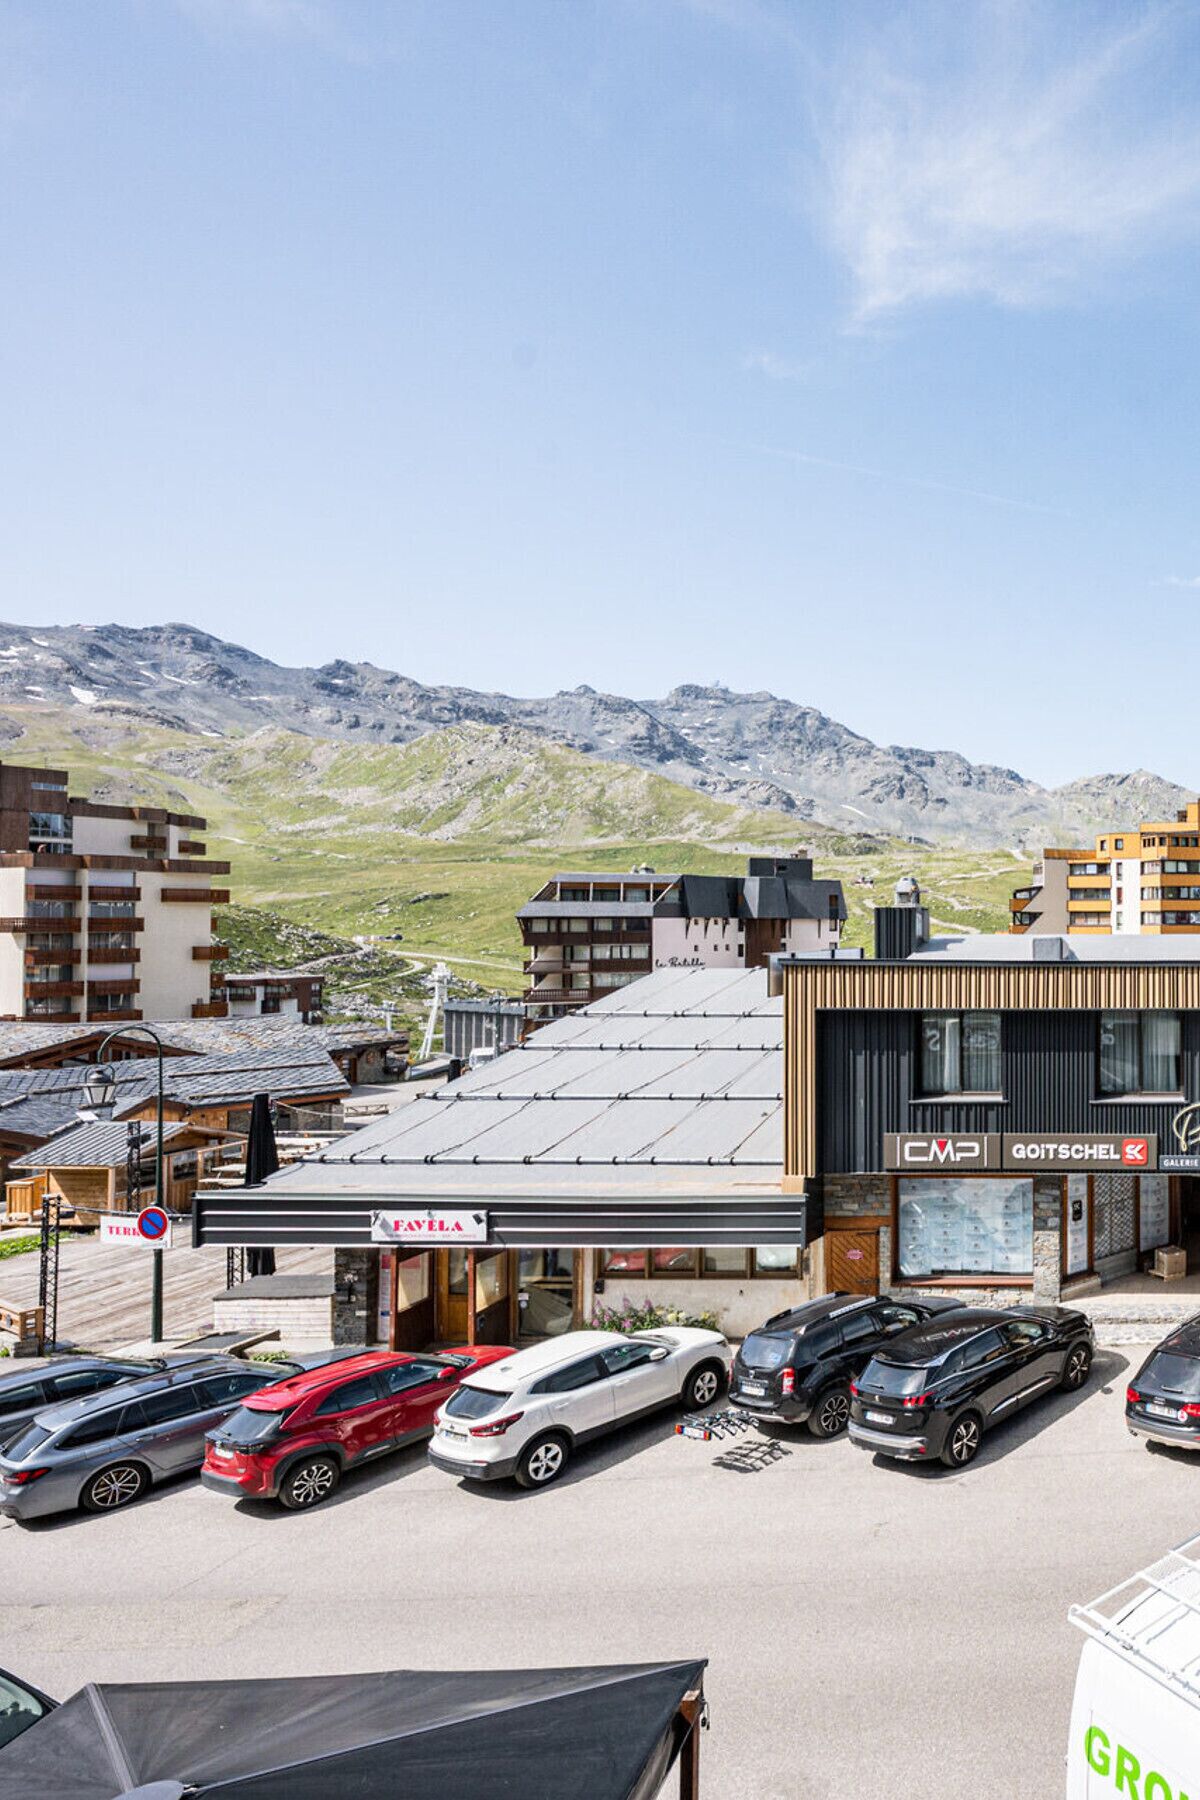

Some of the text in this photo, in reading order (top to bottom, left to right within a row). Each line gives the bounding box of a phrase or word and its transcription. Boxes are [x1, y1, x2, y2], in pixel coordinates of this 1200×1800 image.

[904, 1138, 980, 1163] CMP
[1163, 1159, 1198, 1167] GALERIE
[393, 1219, 464, 1232] FAVELA
